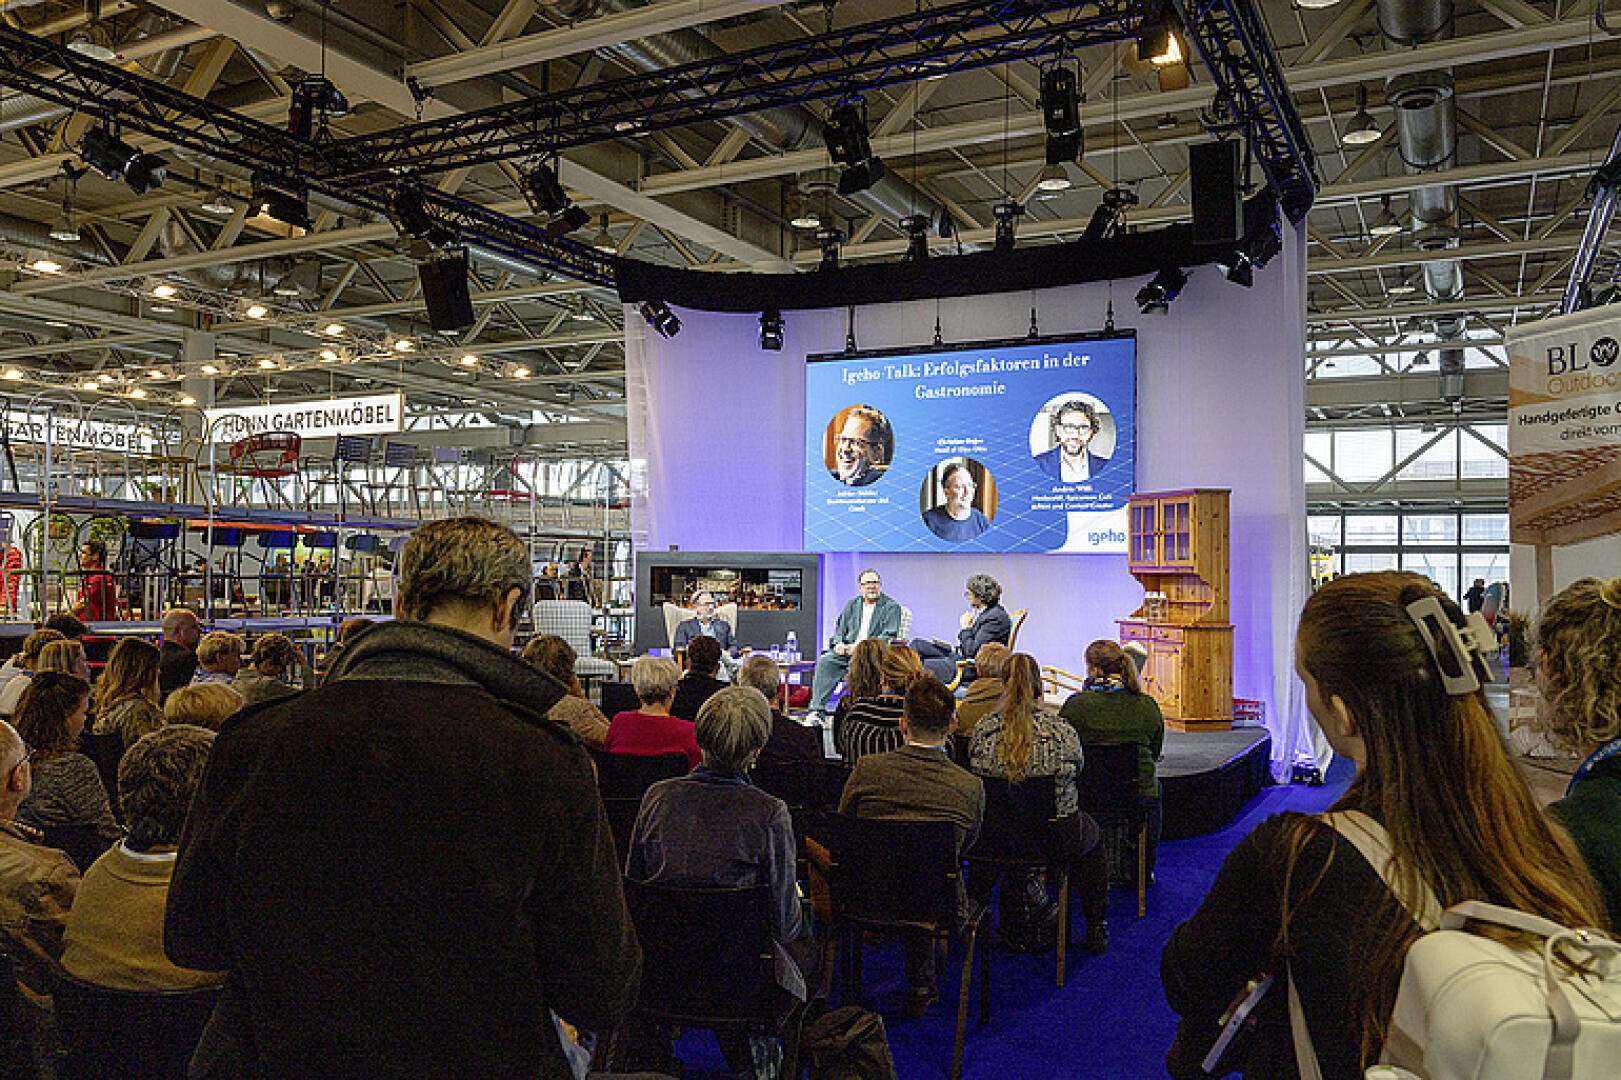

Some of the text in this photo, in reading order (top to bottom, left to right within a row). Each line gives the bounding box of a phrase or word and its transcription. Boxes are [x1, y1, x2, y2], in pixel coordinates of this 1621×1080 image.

[923, 356, 1040, 378] Erfolgsfaktoren
[1043, 353, 1059, 368] in
[1062, 352, 1090, 367] der
[915, 381, 1006, 399] Gastronomie
[272, 402, 394, 430] GARTENMÖBEL
[1518, 405, 1611, 426] Handgefertigte
